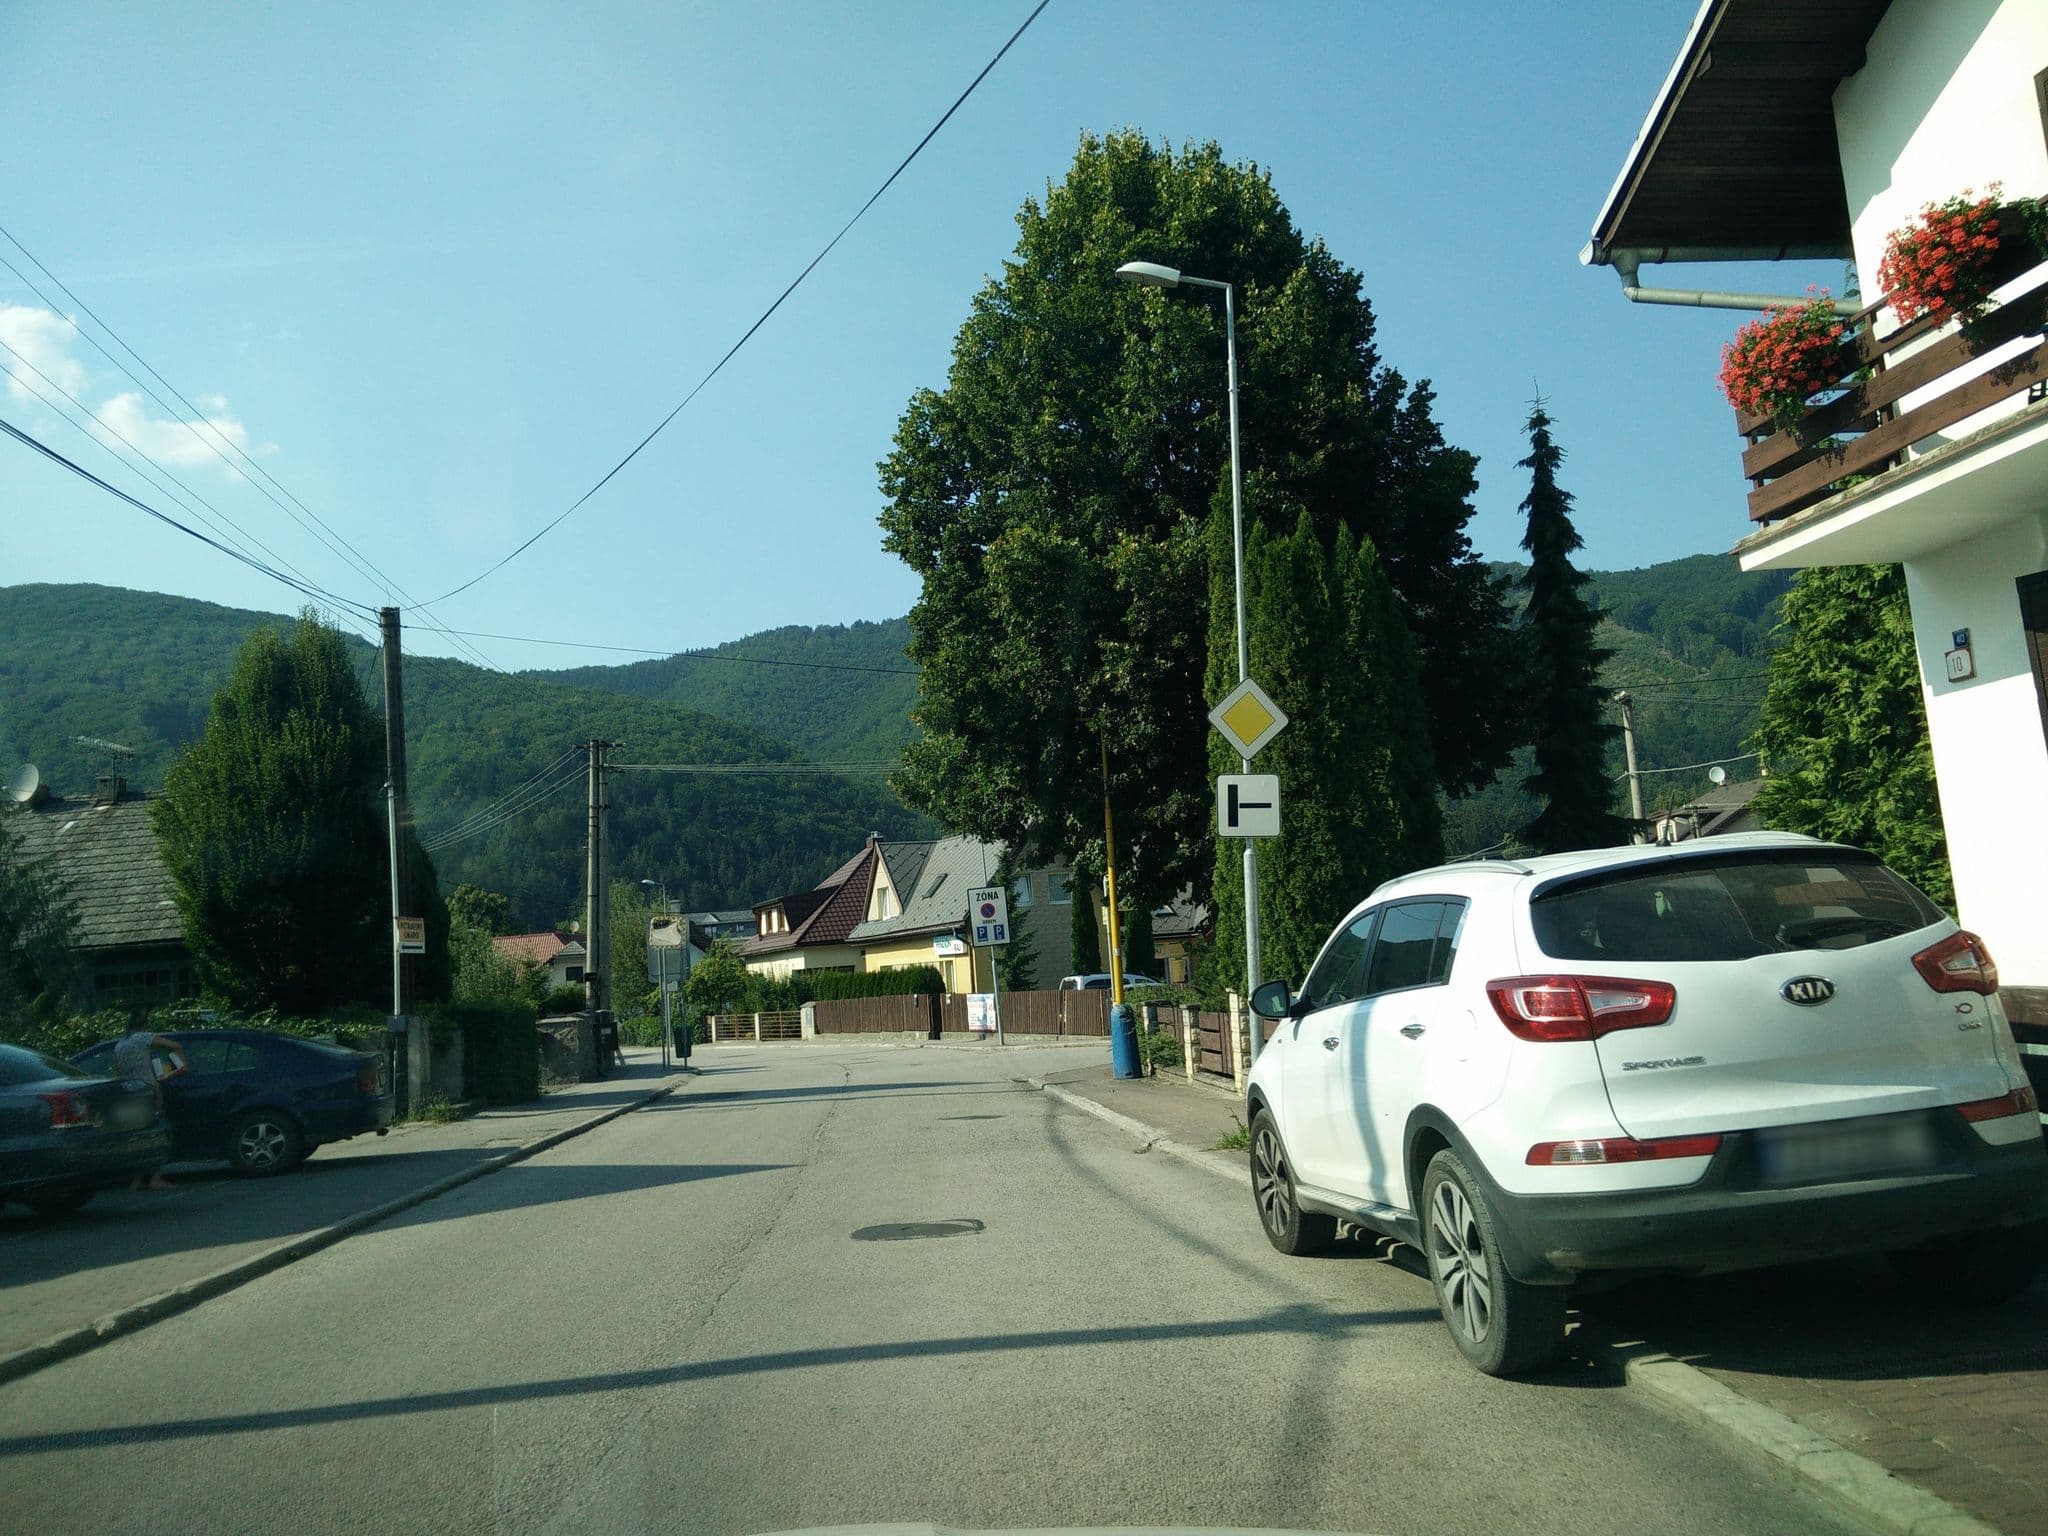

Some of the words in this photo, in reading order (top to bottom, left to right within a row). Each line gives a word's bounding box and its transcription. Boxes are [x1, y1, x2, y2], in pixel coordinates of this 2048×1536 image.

[1952, 656, 1963, 673] 10
[1790, 980, 1831, 1000] KIA
[1621, 1056, 1707, 1071] SPORTAGE
